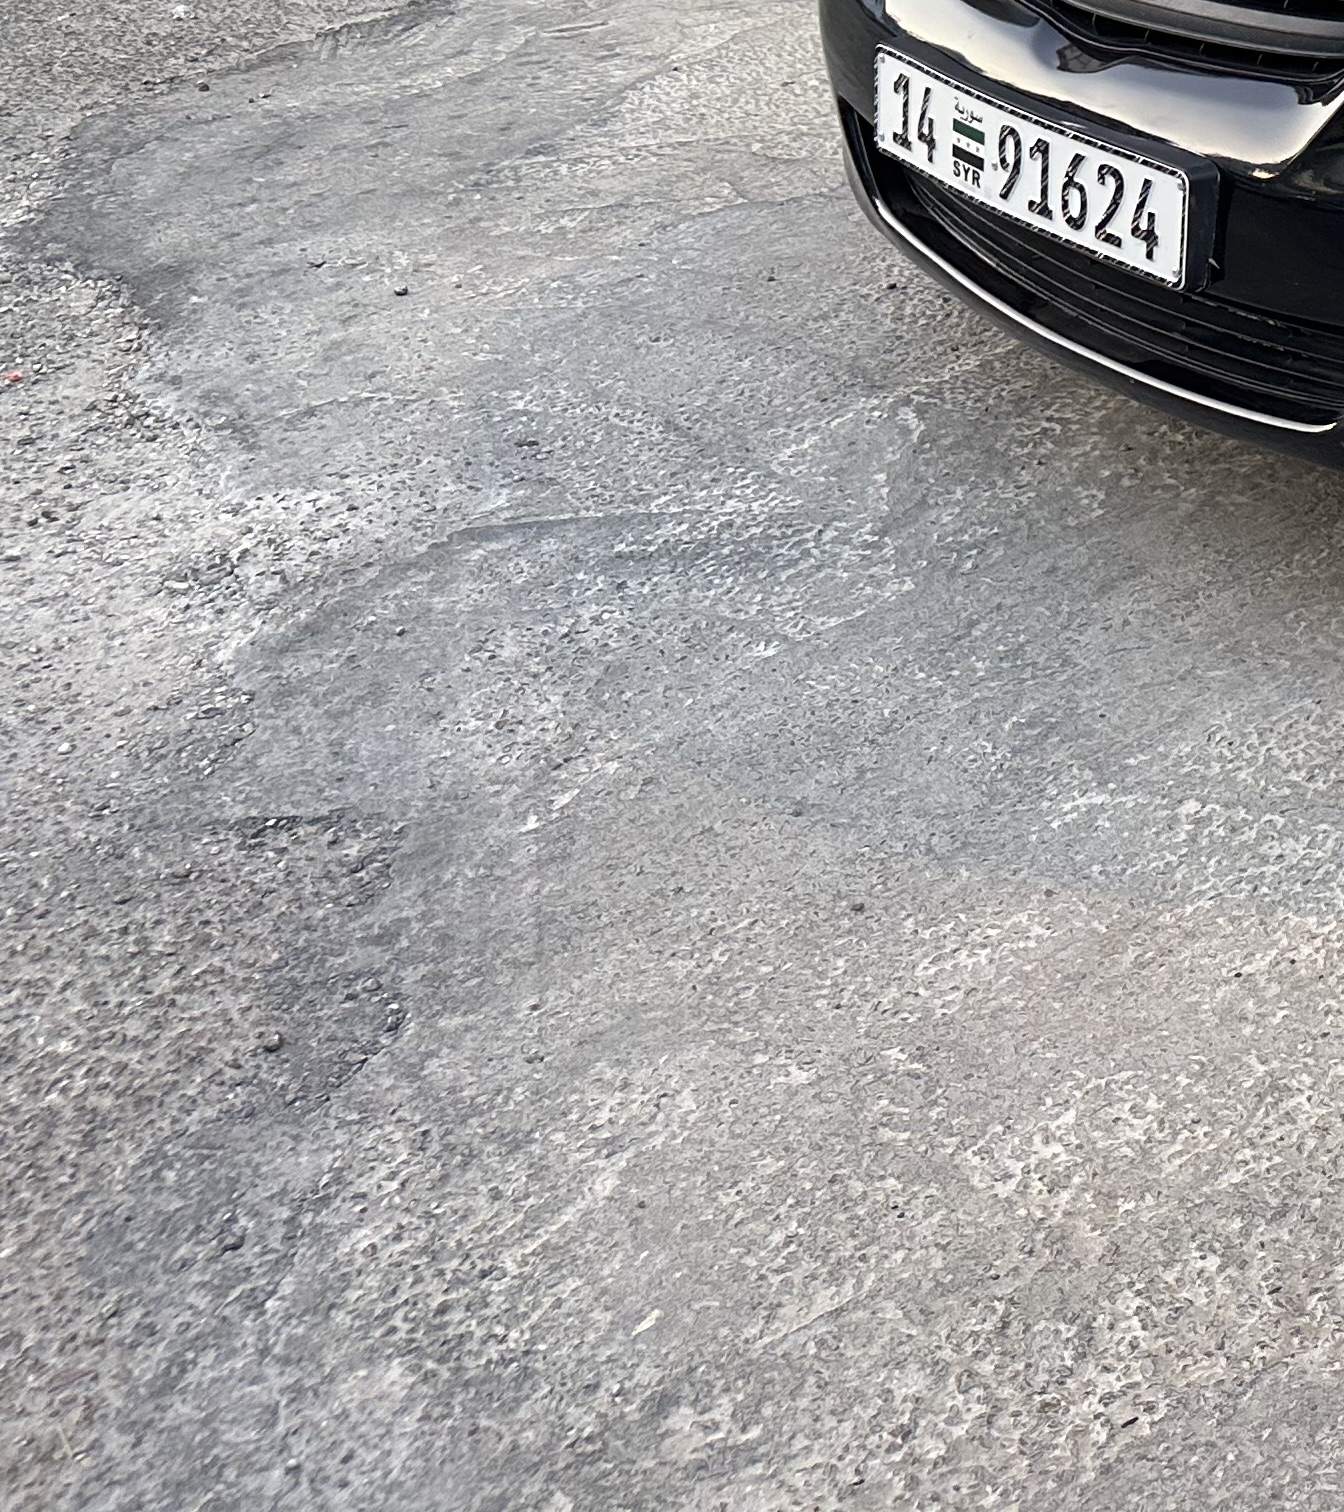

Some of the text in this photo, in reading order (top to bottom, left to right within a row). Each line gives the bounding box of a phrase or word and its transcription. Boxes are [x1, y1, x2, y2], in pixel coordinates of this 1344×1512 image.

[953, 95, 984, 125] سورية
[892, 72, 1160, 261] 14 91624
[952, 160, 982, 189] SYR
